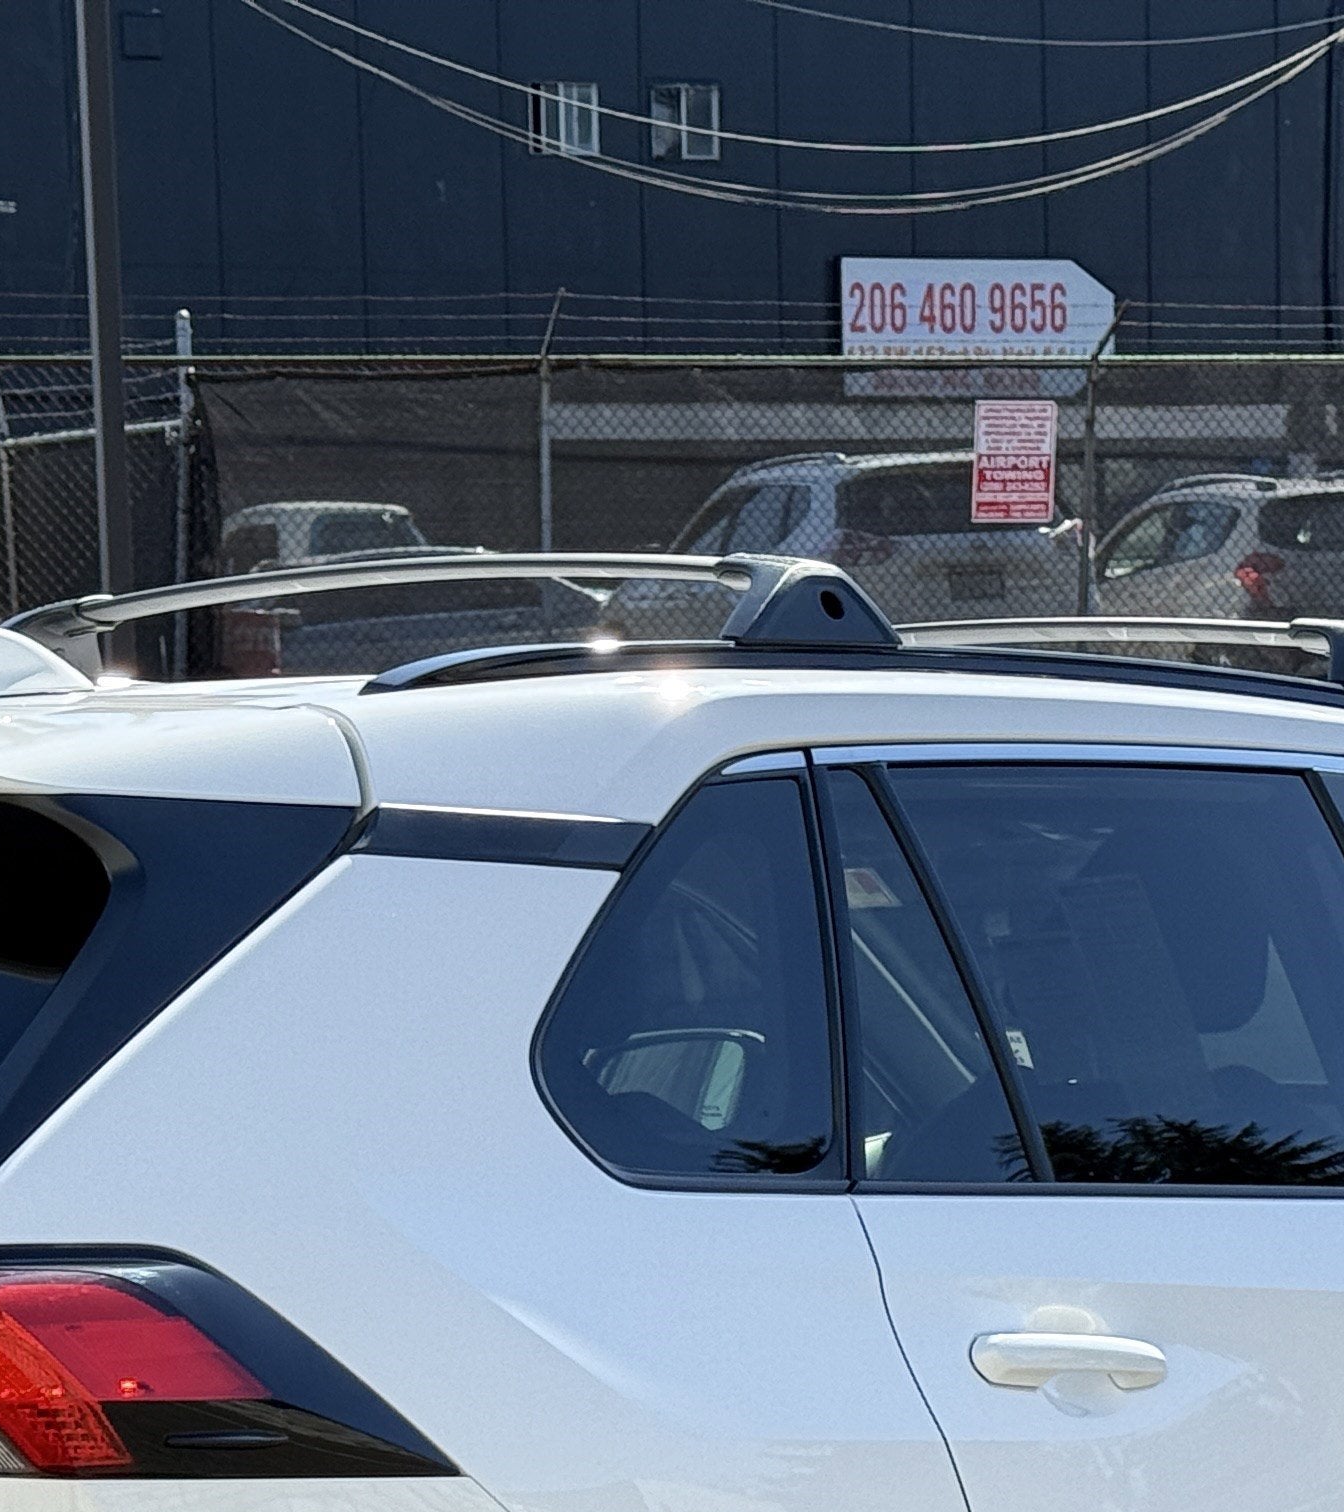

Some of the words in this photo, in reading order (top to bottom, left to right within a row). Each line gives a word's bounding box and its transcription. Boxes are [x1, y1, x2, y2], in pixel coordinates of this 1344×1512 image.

[848, 281, 907, 335] 206
[919, 281, 977, 336] 460
[988, 281, 1068, 336] 9656
[979, 455, 1050, 469] AIRPORT
[983, 470, 1046, 481] TOWING
